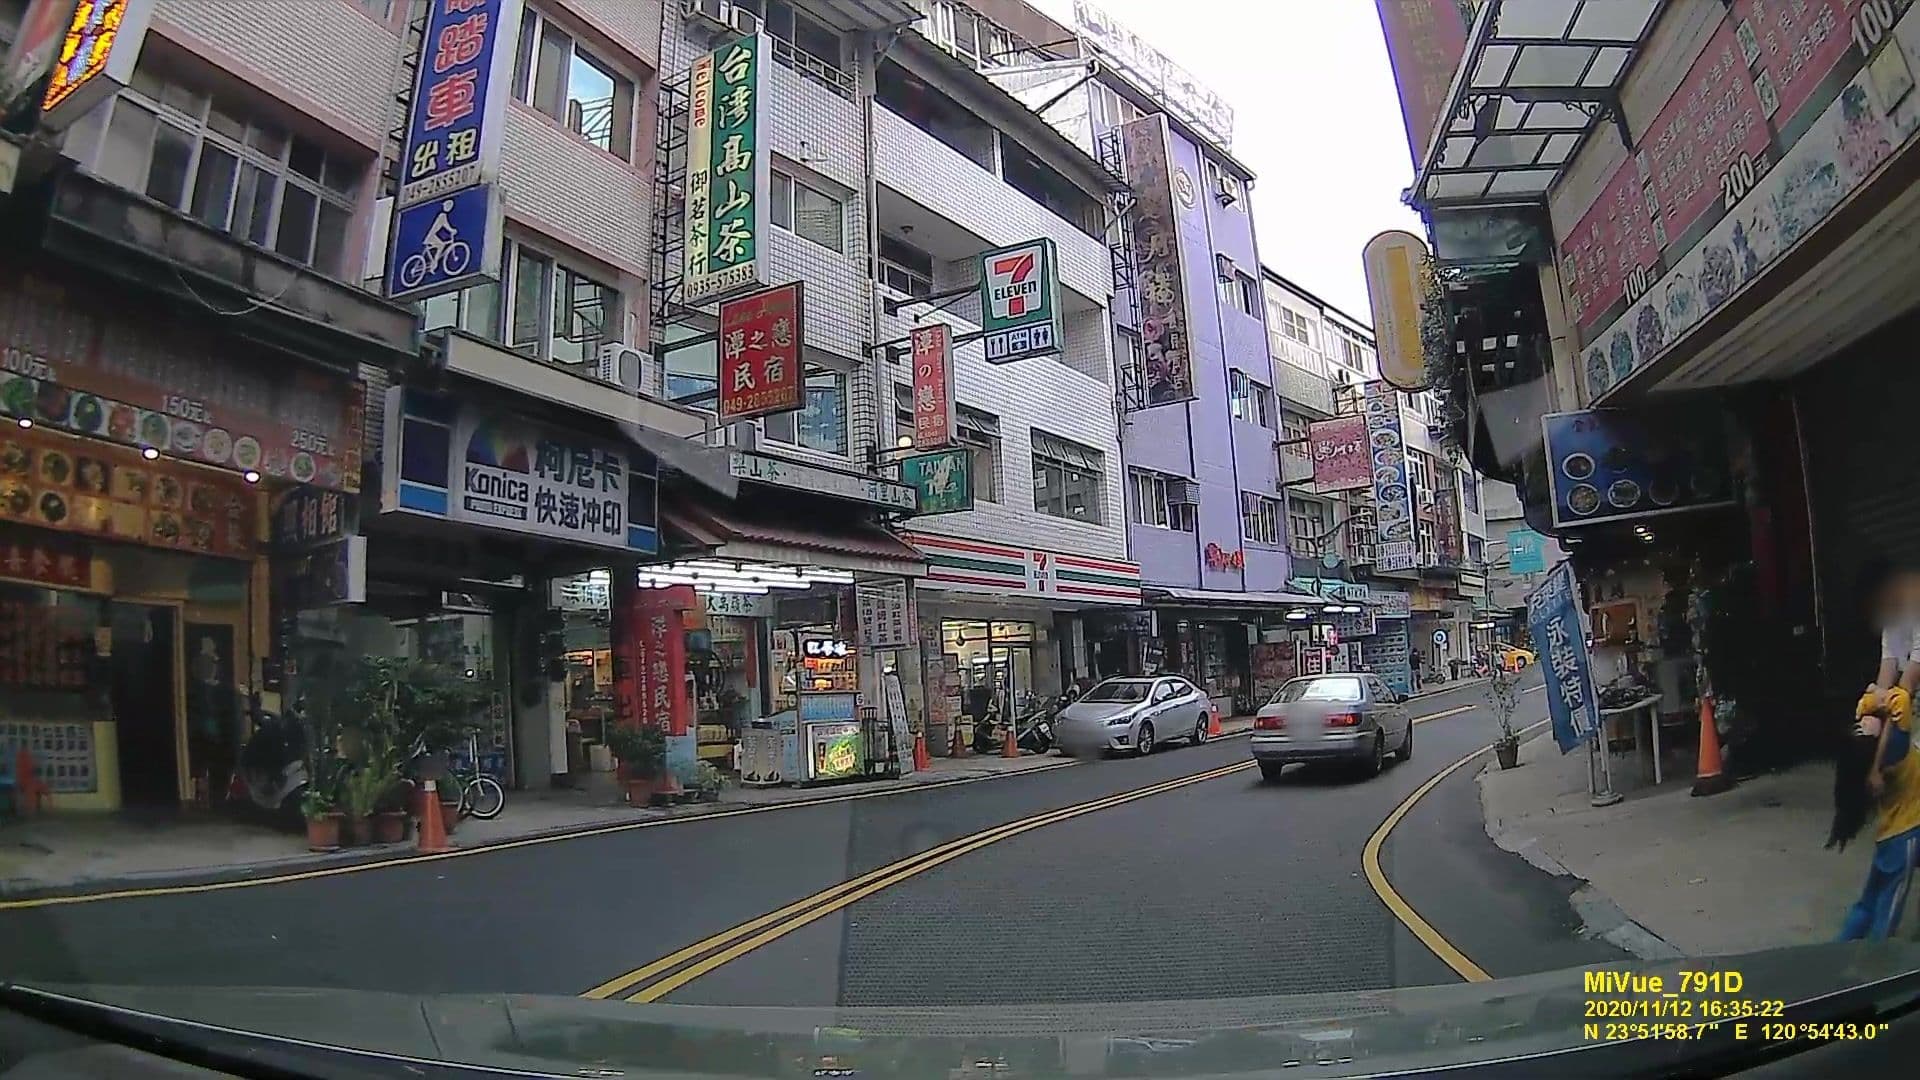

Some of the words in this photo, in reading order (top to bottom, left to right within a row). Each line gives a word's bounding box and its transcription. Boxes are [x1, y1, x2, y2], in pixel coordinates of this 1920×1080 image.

[424, 0, 488, 131] 踏車
[411, 128, 477, 178] 出租
[686, 264, 755, 298] 0935-575383
[724, 318, 792, 360] 潭之戀
[733, 356, 786, 393] 民宿
[464, 466, 530, 503] Konica
[534, 440, 622, 493] 柯尼卡
